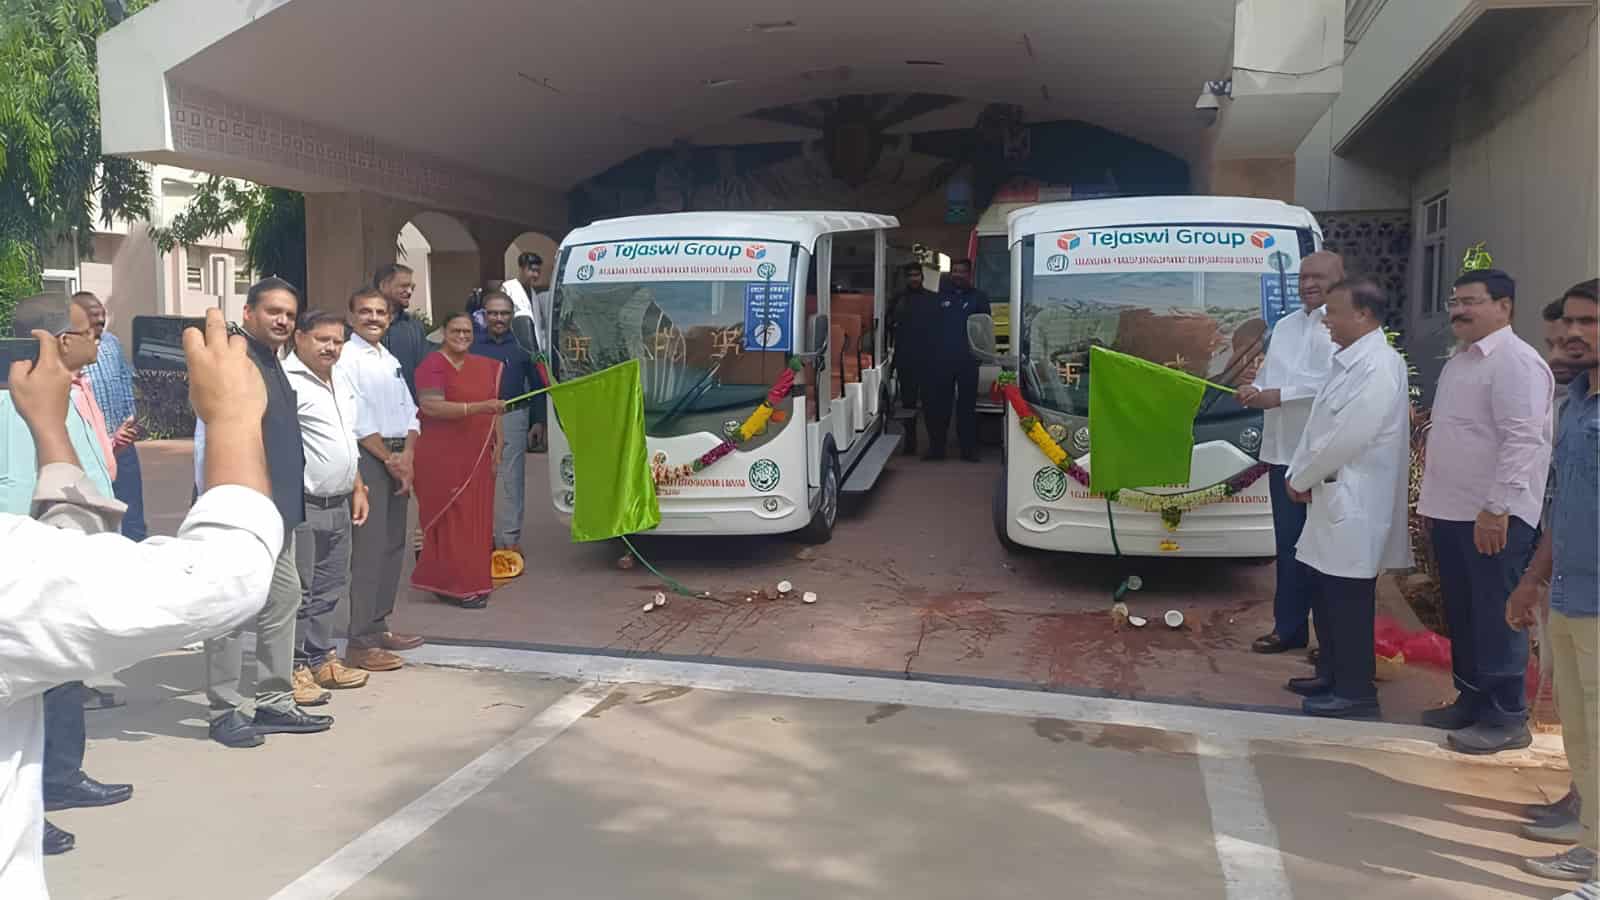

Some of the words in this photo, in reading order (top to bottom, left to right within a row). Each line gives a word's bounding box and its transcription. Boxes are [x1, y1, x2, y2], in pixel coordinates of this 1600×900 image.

[1088, 228, 1169, 249] Tejaswi
[1176, 229, 1246, 248] Group
[684, 242, 742, 260] Group
